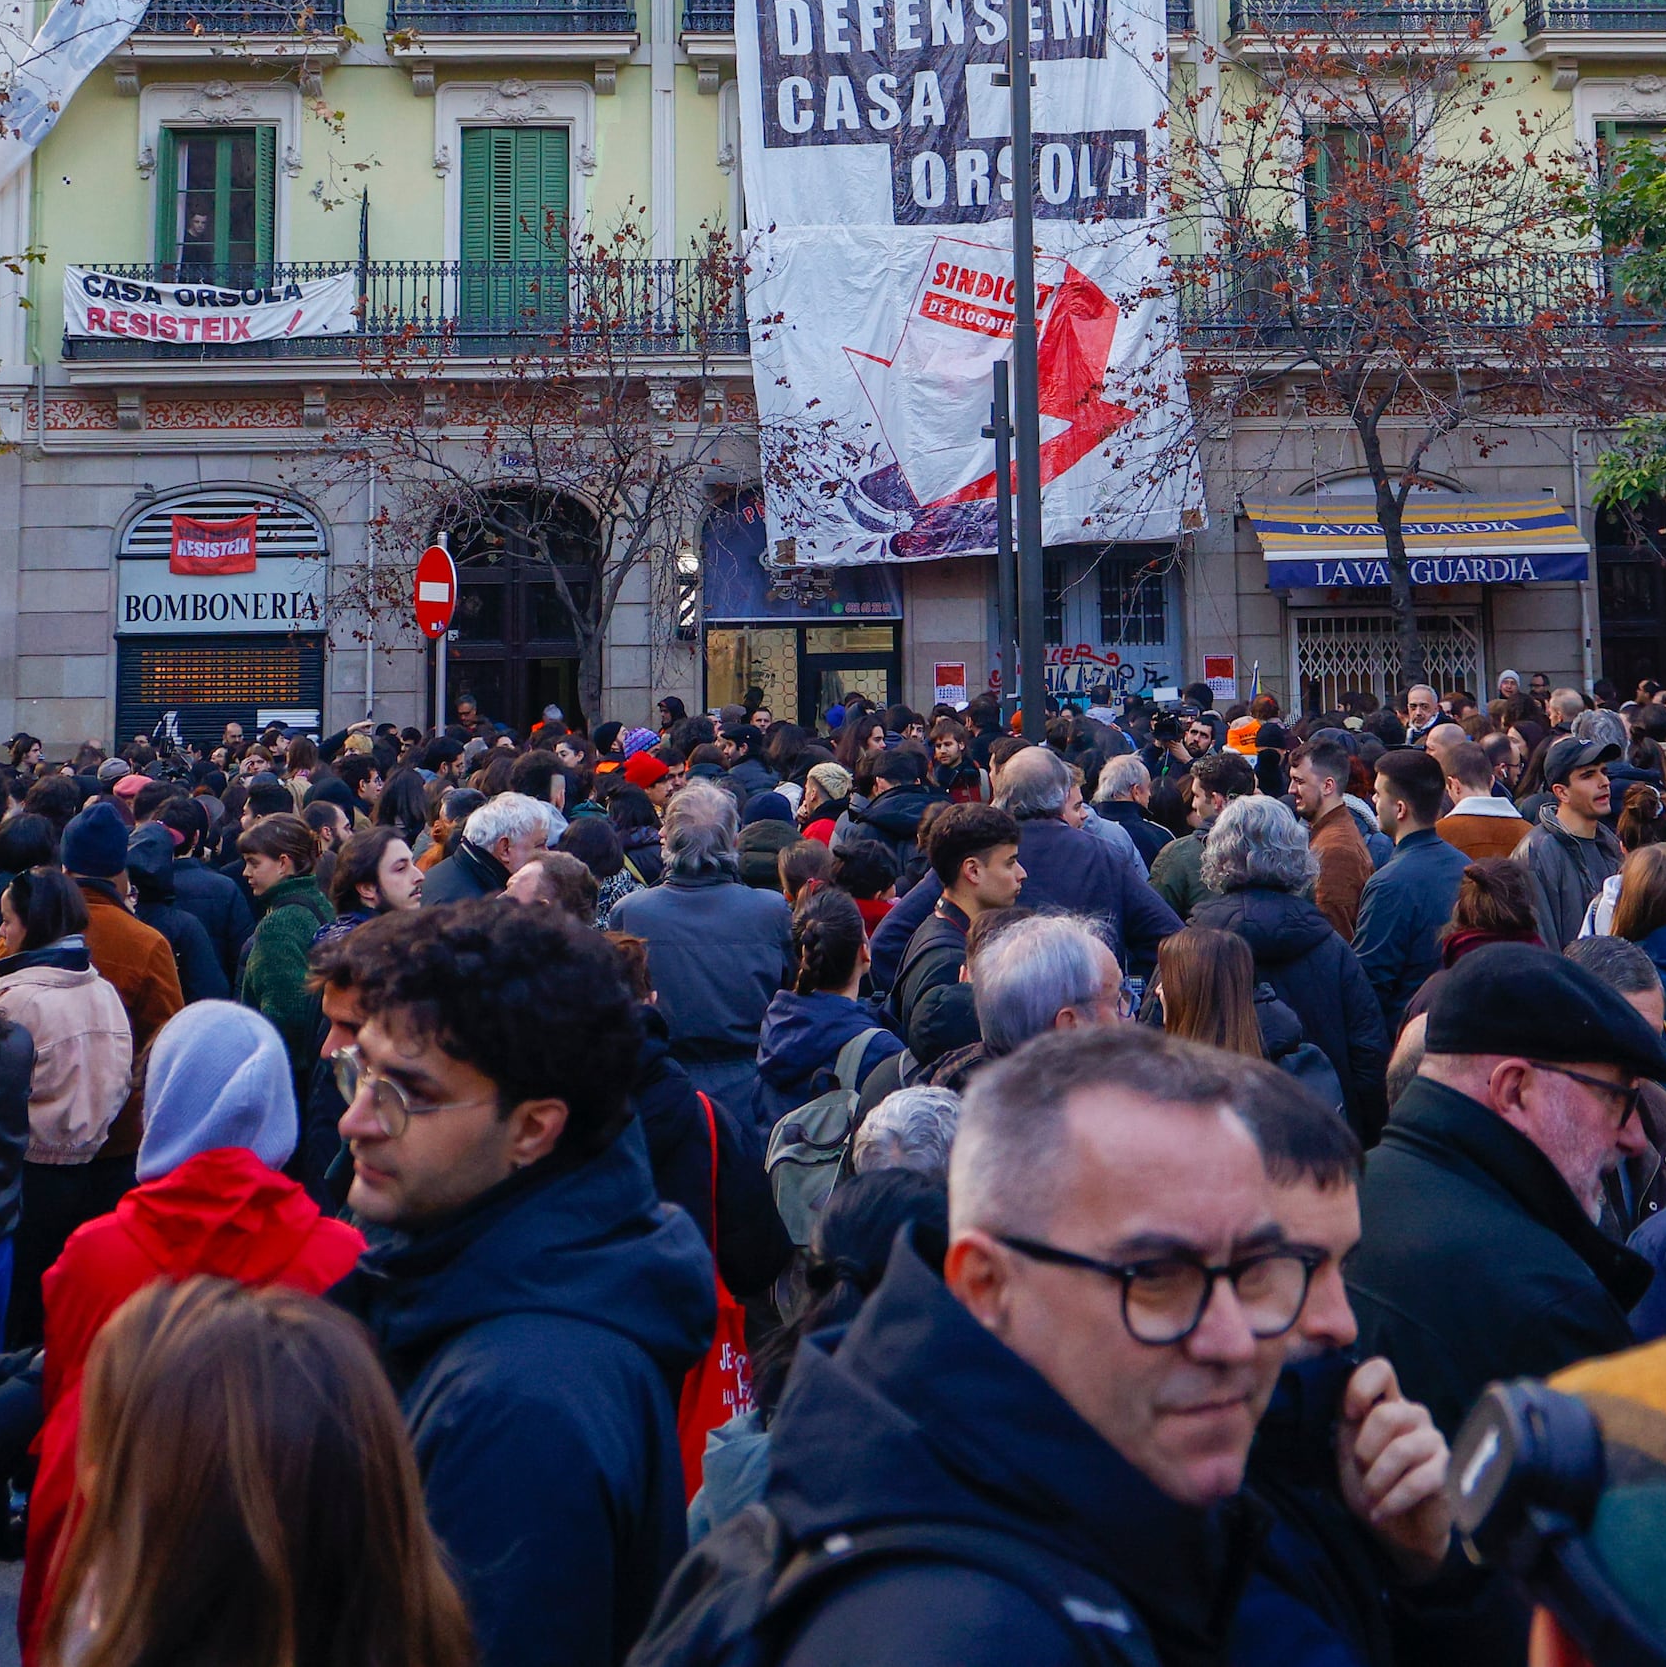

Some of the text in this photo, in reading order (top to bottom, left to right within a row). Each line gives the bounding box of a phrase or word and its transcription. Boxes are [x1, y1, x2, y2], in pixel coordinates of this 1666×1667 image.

[777, 70, 946, 134] CASA
[83, 275, 303, 307] CASA ORSOLA
[932, 261, 1054, 310] SINDICT
[928, 299, 947, 316] DE
[87, 307, 252, 342] RESISTEIX
[176, 537, 251, 559] RESISTEIX
[124, 592, 320, 622] BOMBONERIA
